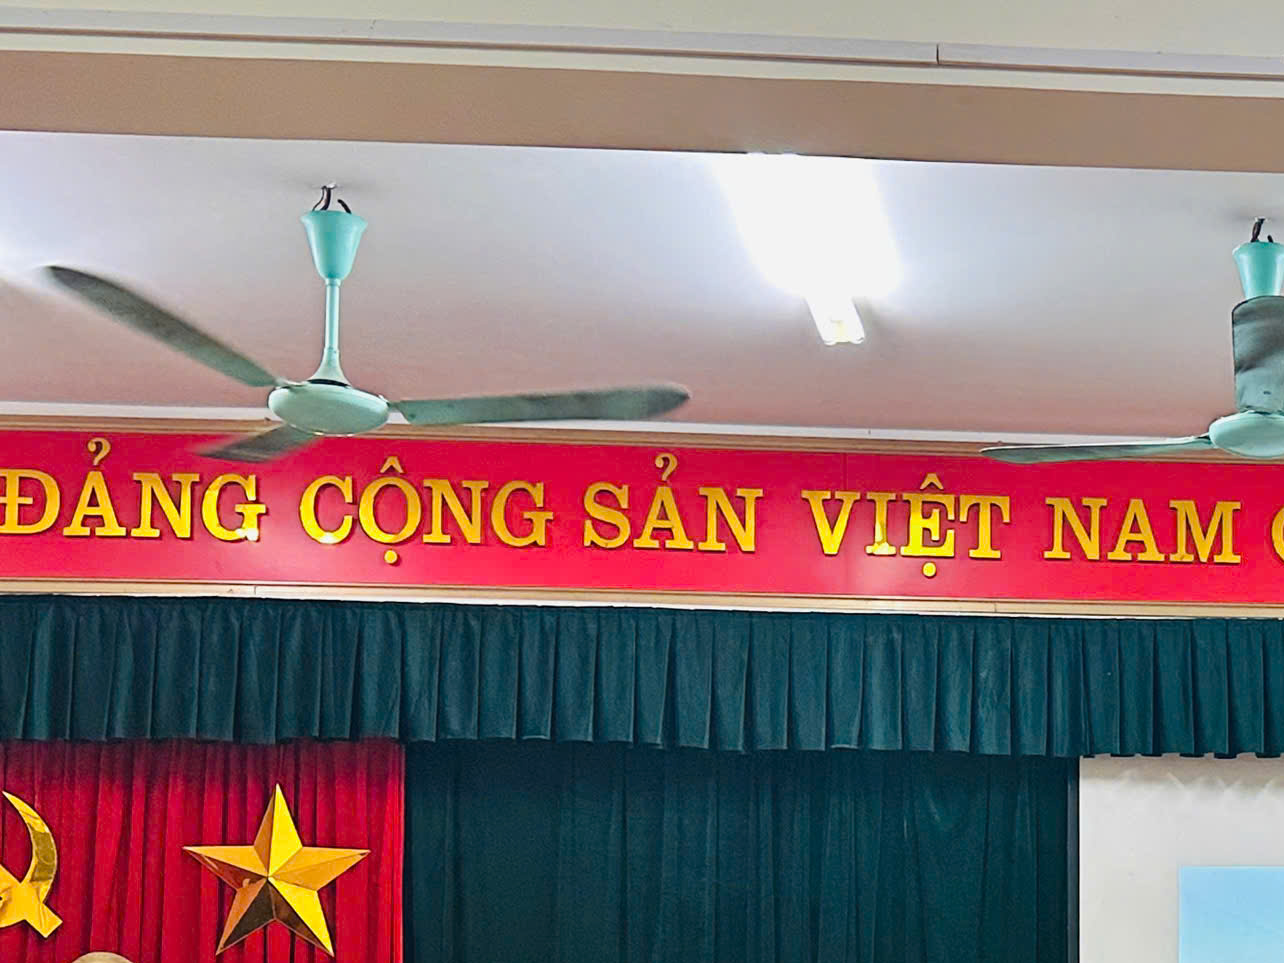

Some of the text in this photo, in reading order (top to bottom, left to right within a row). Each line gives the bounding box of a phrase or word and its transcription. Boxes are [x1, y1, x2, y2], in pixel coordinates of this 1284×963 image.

[0, 437, 268, 543] ĐẢNG
[298, 457, 554, 565] CỘNG
[583, 452, 763, 552] SẢN
[801, 473, 1012, 578] VIỆT
[1043, 496, 1242, 565] NAM
